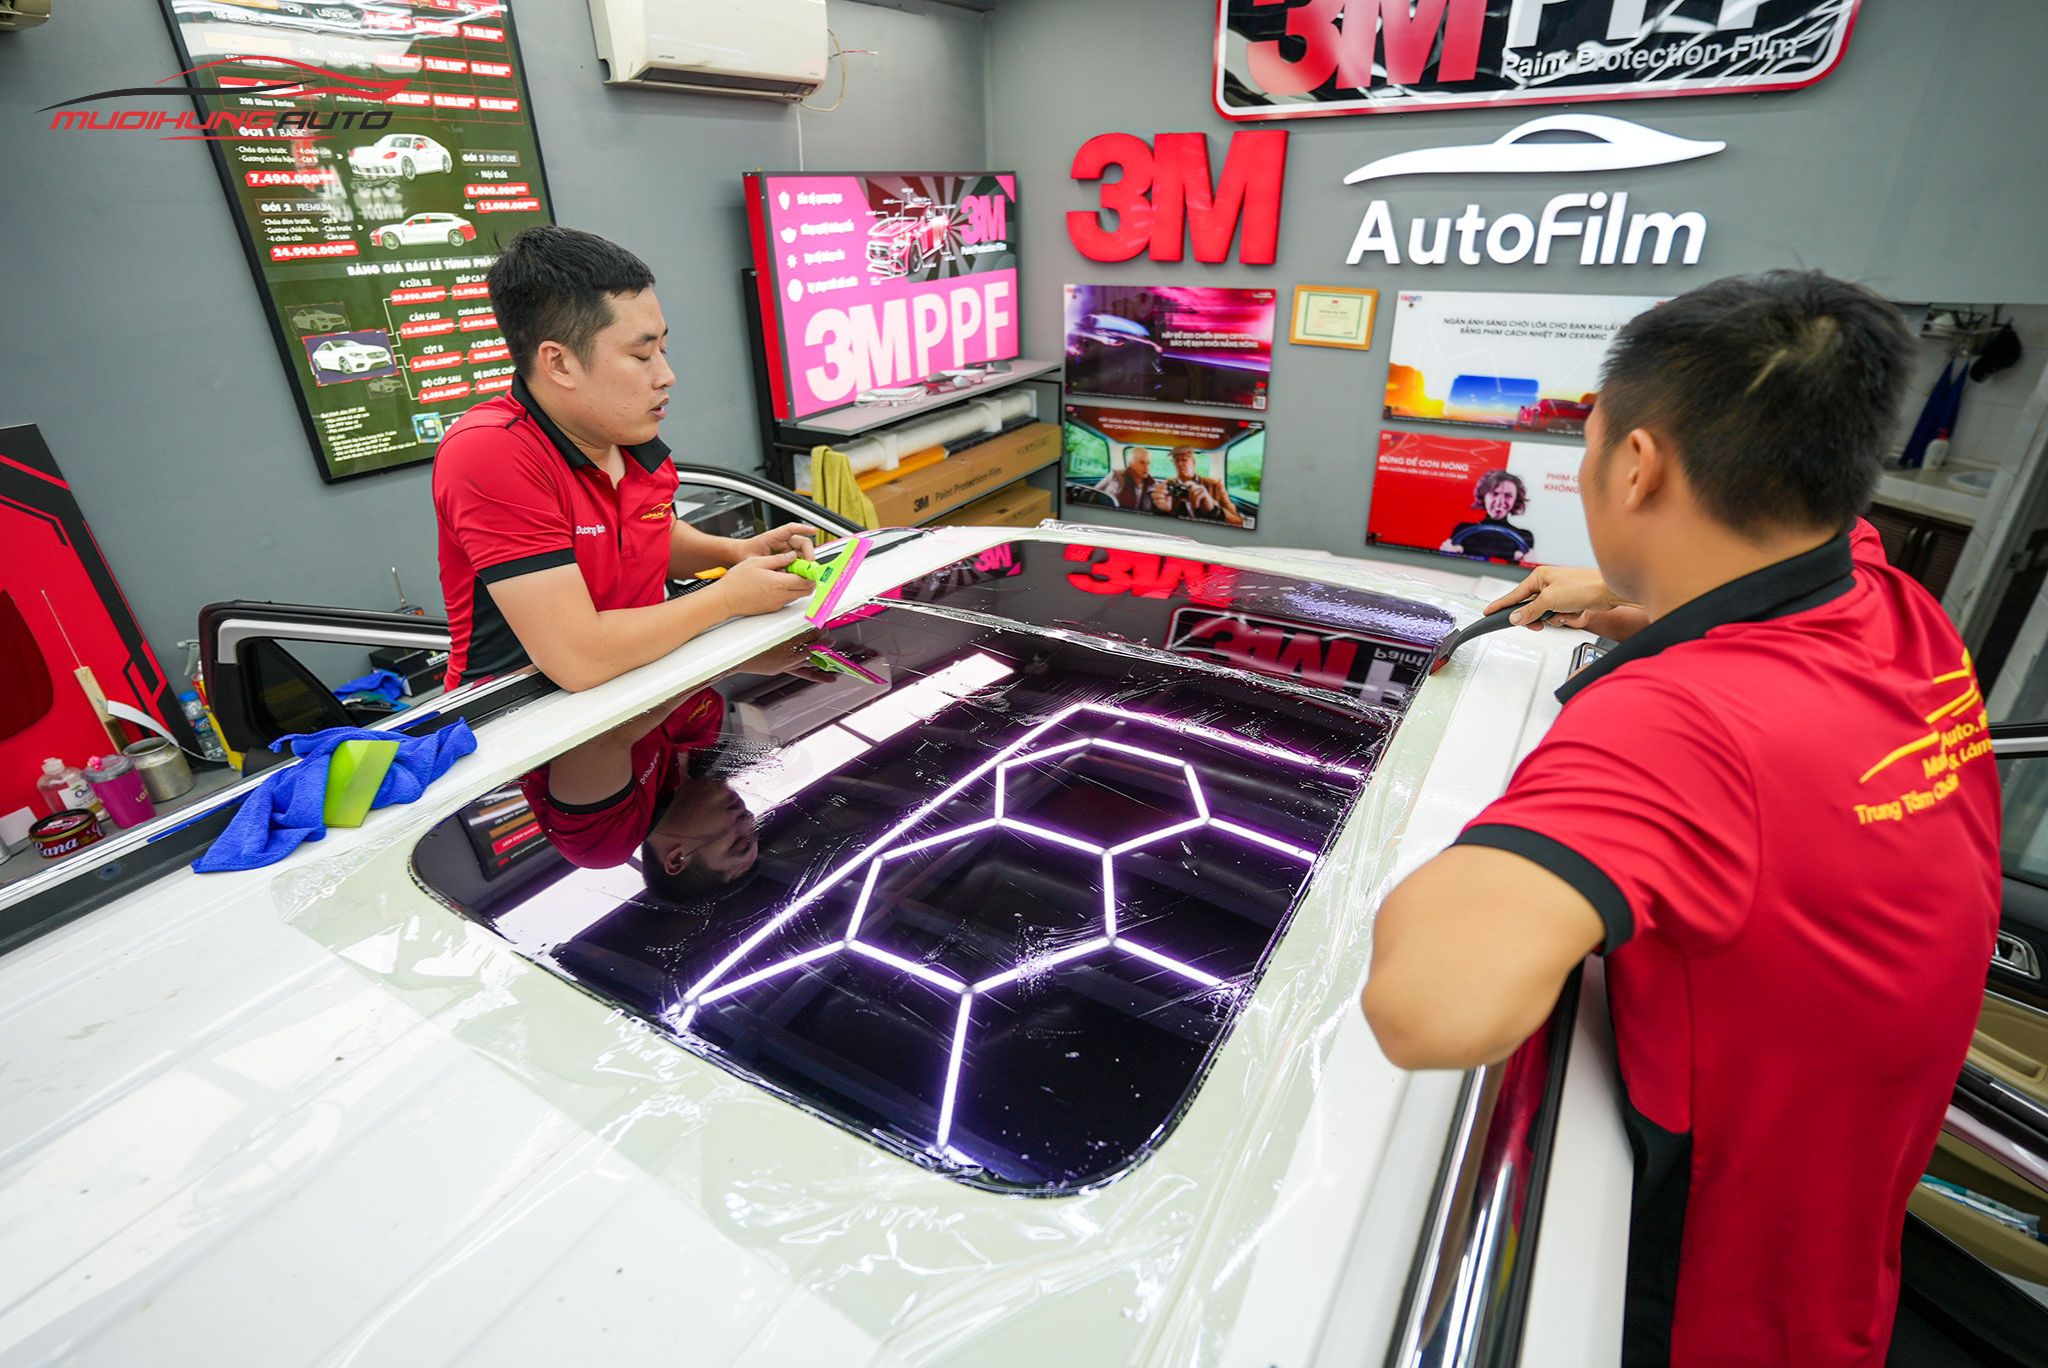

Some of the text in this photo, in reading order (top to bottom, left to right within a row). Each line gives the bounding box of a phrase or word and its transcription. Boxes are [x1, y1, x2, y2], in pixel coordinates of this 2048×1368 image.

[1501, 34, 1797, 78] Paint Protection Film
[279, 127, 307, 137] BASIC
[284, 204, 292, 212] 2
[296, 203, 333, 212] PREMIUM
[1066, 130, 1289, 264] 3M
[960, 195, 1007, 245] 3M
[1345, 191, 1707, 265] AutoFilm
[346, 263, 380, 276] BẢNG
[383, 261, 404, 273] GIÁ
[405, 260, 429, 272] BÁN
[1568, 332, 1607, 341] CERAMIC
[1441, 460, 1469, 471] NÓNG
[1547, 473, 1570, 482] PHIM
[914, 467, 1003, 512] 3M Paint Protection Film
[1853, 800, 1903, 825] Trung
[1900, 790, 1935, 814] Tâm
